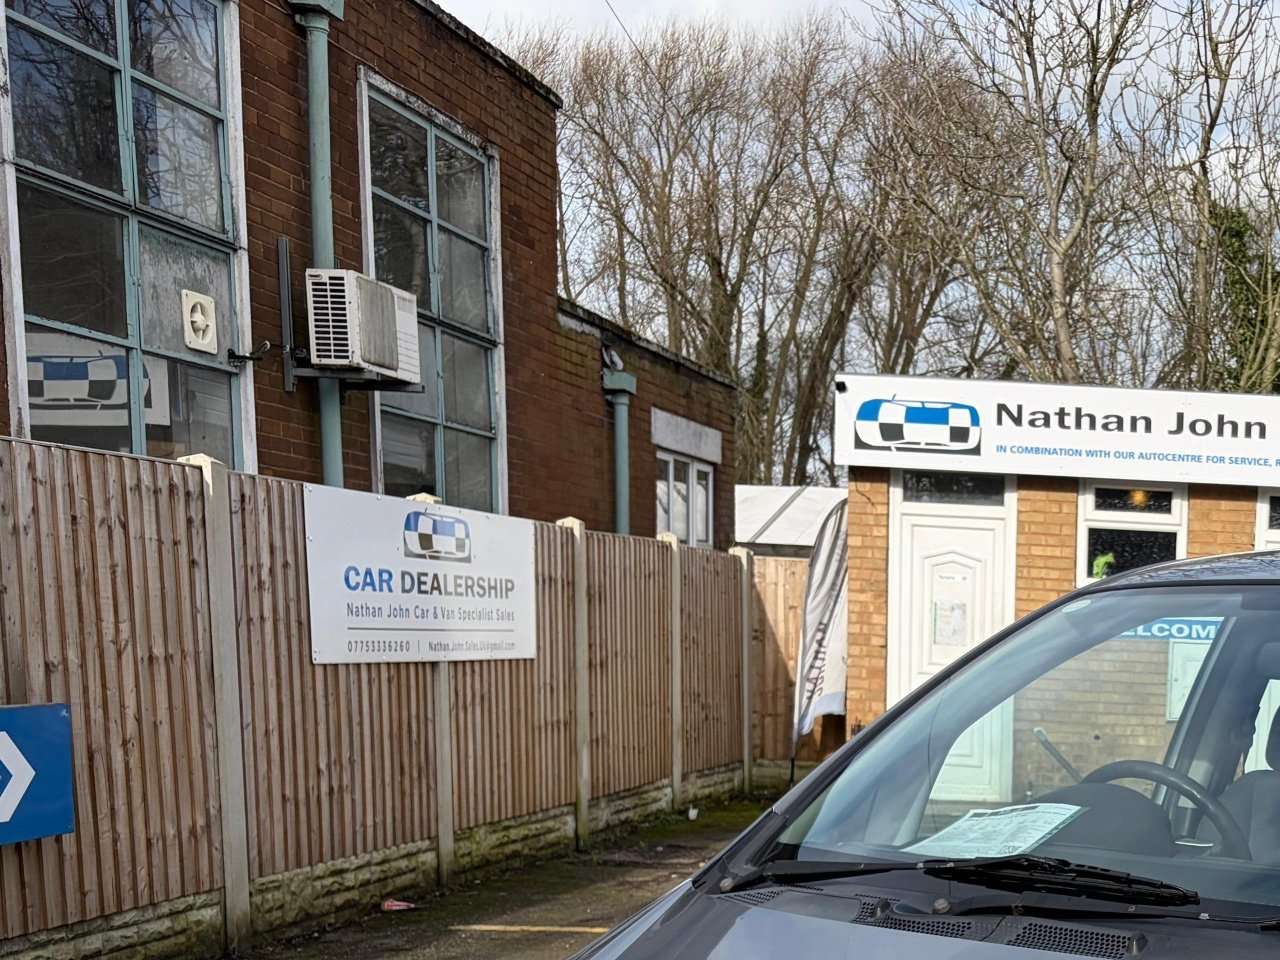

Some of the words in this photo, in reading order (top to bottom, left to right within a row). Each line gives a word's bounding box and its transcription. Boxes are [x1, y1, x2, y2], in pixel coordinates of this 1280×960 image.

[996, 403, 1152, 433] Nathan
[1168, 412, 1266, 439] John
[996, 445, 1007, 454] IN
[1010, 445, 1082, 457] COMBINATION
[1085, 450, 1111, 459] WITH
[1114, 451, 1135, 460] OUR
[1138, 452, 1203, 464] AUTOCENTRE
[1206, 455, 1226, 464] FOR
[1228, 457, 1273, 468] SERVICE,
[344, 565, 393, 593] CAR
[400, 570, 515, 599] DEALERSHIP
[347, 602, 383, 618] Nathan
[387, 603, 410, 618] John
[414, 605, 429, 619] Car
[433, 605, 439, 619] &
[440, 606, 455, 620] Van
[458, 607, 494, 622] Specialist
[495, 608, 514, 621] Sales
[1121, 623, 1218, 639] LCOM
